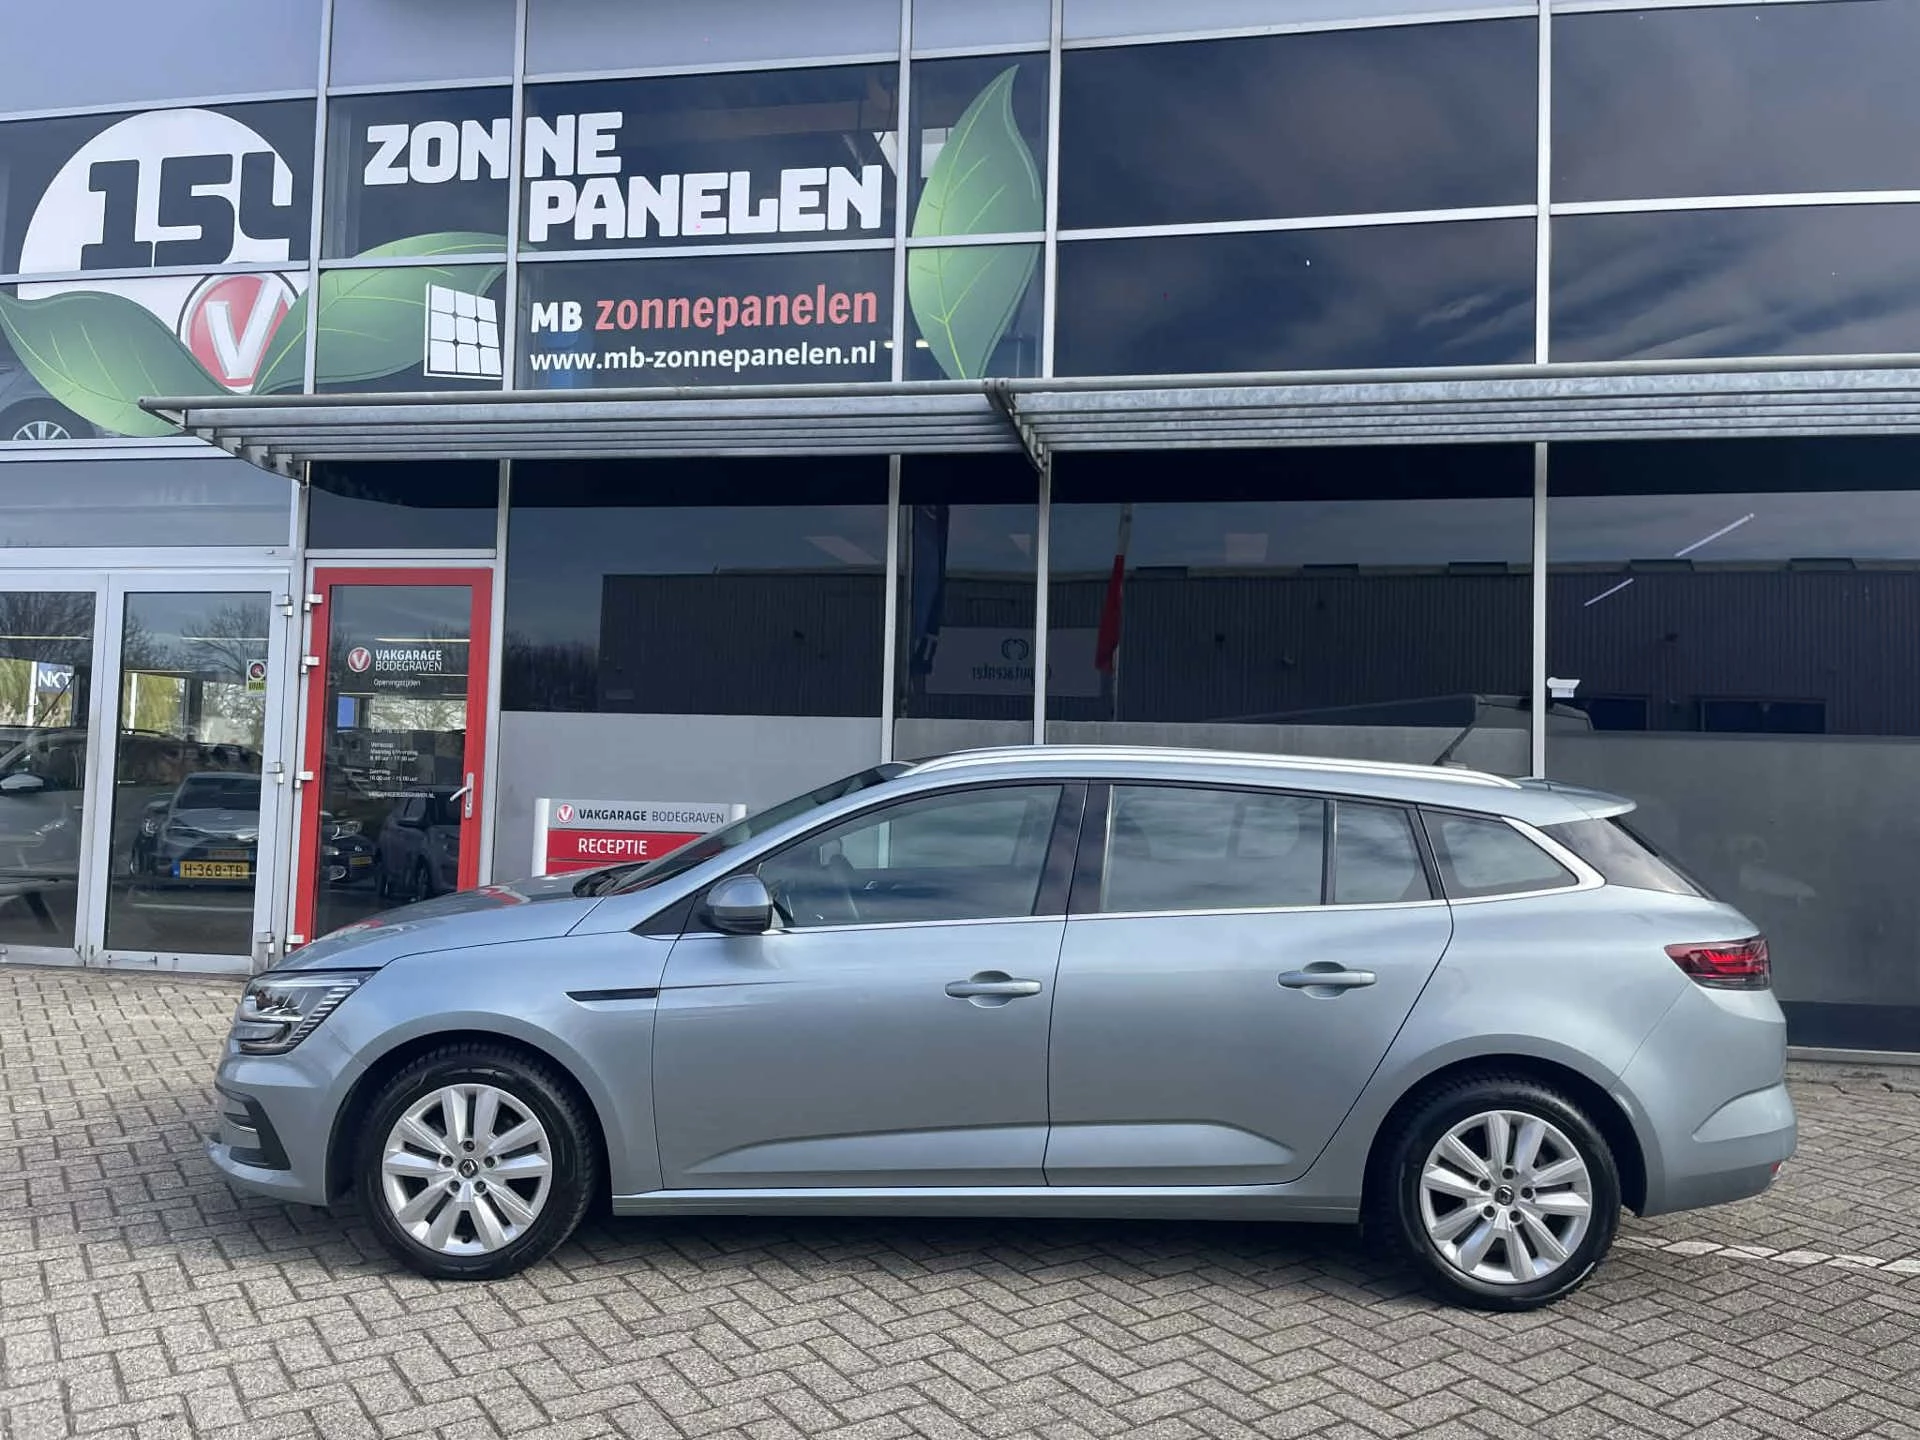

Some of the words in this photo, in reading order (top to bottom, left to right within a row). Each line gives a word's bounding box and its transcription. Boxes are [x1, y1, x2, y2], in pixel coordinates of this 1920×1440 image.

[364, 111, 623, 186] ZONNE
[80, 151, 293, 270] 154
[528, 165, 882, 242] PANELEN
[531, 302, 583, 333] MB
[595, 284, 877, 335] zonnepanelen
[530, 340, 876, 372] www.mb-zonnepanelen.nl
[375, 649, 442, 661] VAKGARAGE
[375, 660, 442, 672] BODEGRAVEN
[579, 809, 647, 821] VAKGARAGE
[652, 810, 724, 824] BODEGRAVEN
[578, 838, 648, 855] RECEPTIE
